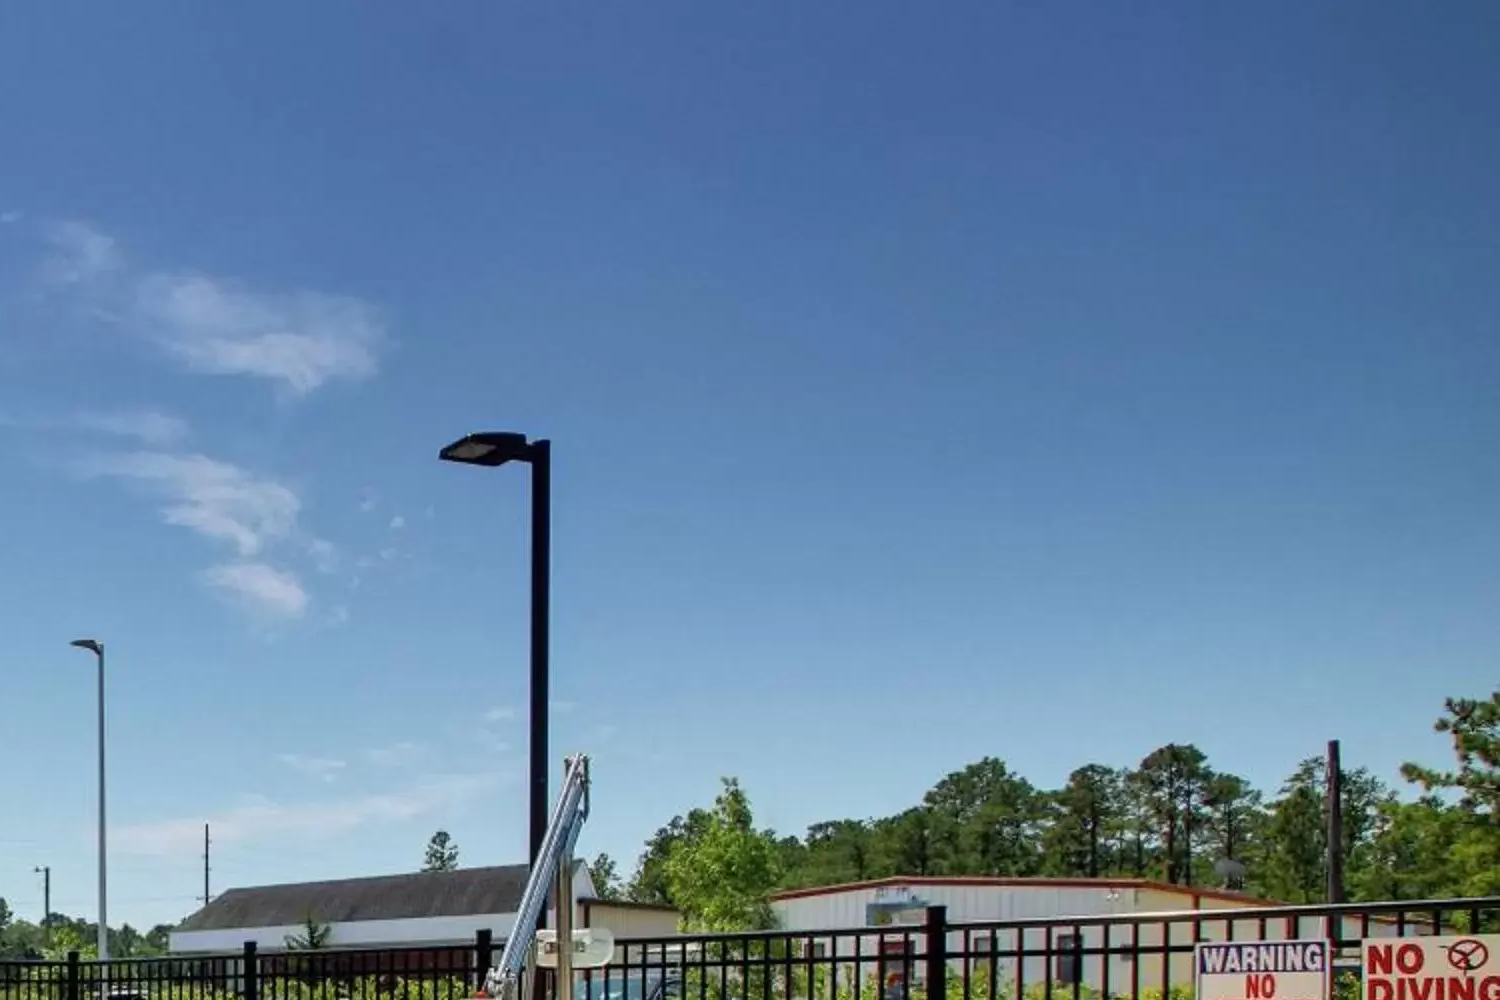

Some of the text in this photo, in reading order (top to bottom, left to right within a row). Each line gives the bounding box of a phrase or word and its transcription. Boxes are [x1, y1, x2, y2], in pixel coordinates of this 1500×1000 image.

[1202, 943, 1323, 973] WARNING
[1366, 944, 1424, 974] NO
[1245, 974, 1275, 999] NO
